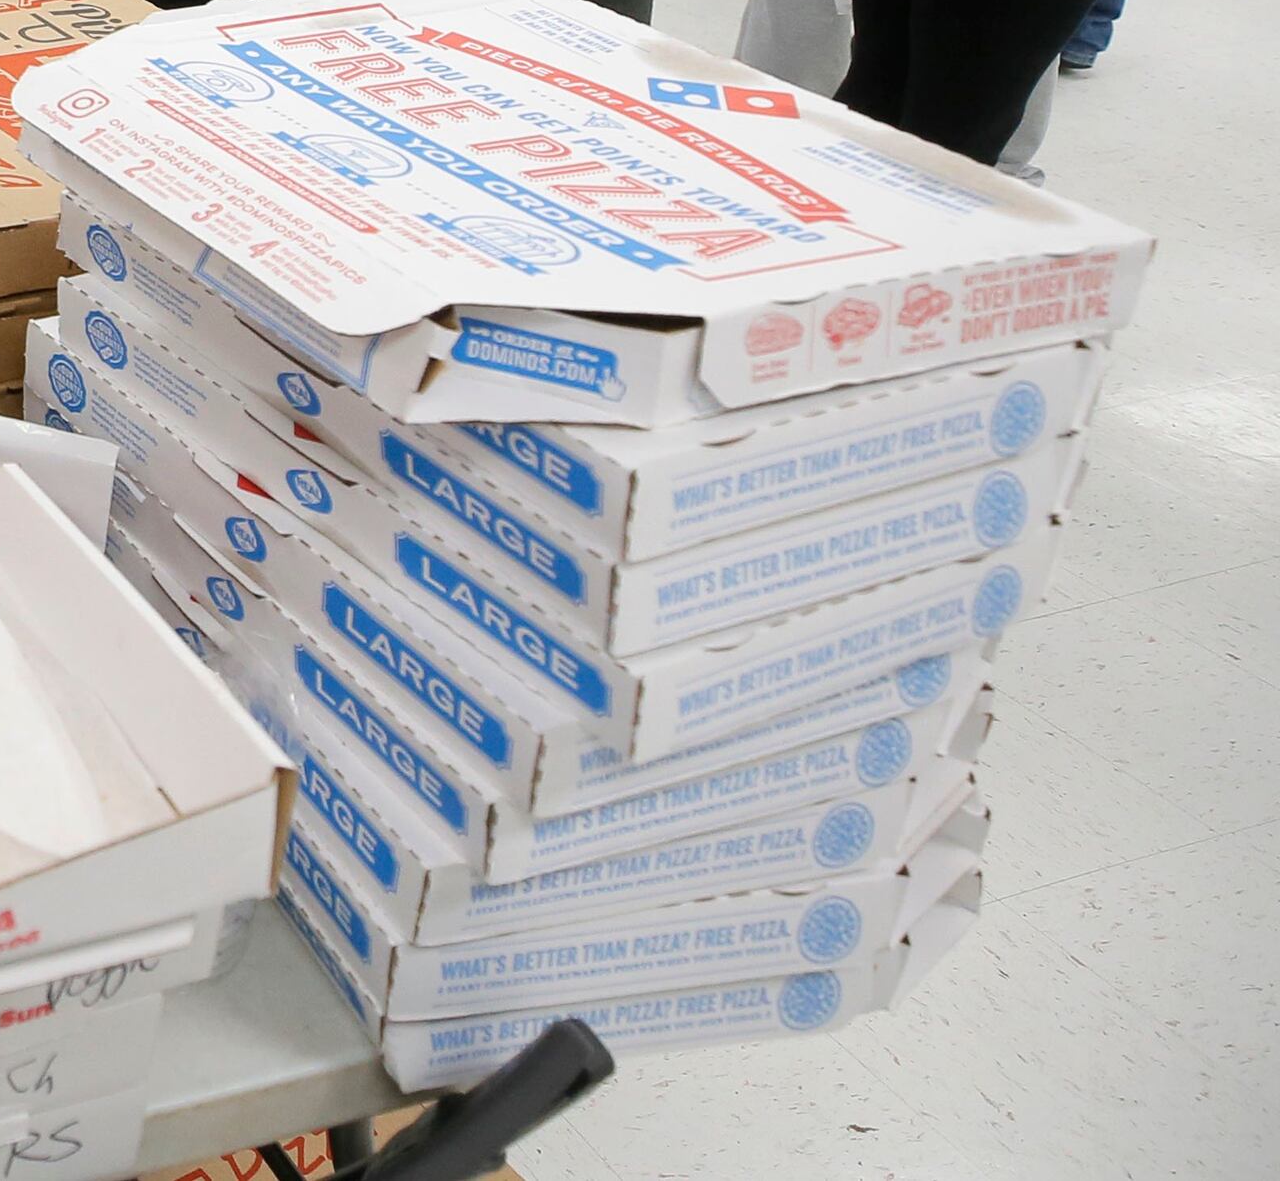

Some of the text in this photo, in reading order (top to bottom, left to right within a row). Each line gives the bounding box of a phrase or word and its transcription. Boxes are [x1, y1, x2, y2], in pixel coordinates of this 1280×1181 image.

[79, 127, 107, 145] 1
[108, 119, 128, 132] ON
[126, 129, 197, 174] INSTAGRAM
[193, 174, 226, 196] WITH
[123, 159, 156, 179] 2
[260, 63, 627, 248] ANY WAY YOU ORDER
[274, 29, 501, 130] FREE
[465, 134, 776, 261] PIZZA
[355, 25, 828, 244] NOW YOU CAN GET POINTS TOWARD
[460, 41, 555, 78] PIECE
[624, 105, 680, 132] PIE
[680, 131, 820, 209] REWARDS
[174, 144, 222, 173] SHARE
[218, 172, 257, 196] YOUR
[256, 193, 314, 233] REWARD
[192, 202, 224, 223] 3
[248, 240, 281, 259] 4
[466, 338, 598, 386] DOMINOS.COM
[493, 330, 552, 355] ORDER
[474, 423, 574, 492] RGE
[403, 452, 558, 581] LARGE
[420, 556, 580, 691] LARGE
[344, 605, 485, 743] LARGE
[314, 670, 443, 809] LARGE
[301, 764, 378, 864] RGE
[292, 840, 354, 936] RGE
[441, 947, 507, 981] WHAT'S
[512, 938, 578, 975] BETTER
[582, 932, 628, 964] THAN
[638, 927, 691, 958] PIZZA?
[694, 924, 734, 950] FREE
[430, 1022, 494, 1053] WHAT'S
[614, 998, 672, 1026] PIZZA?
[676, 992, 719, 1018] FREE
